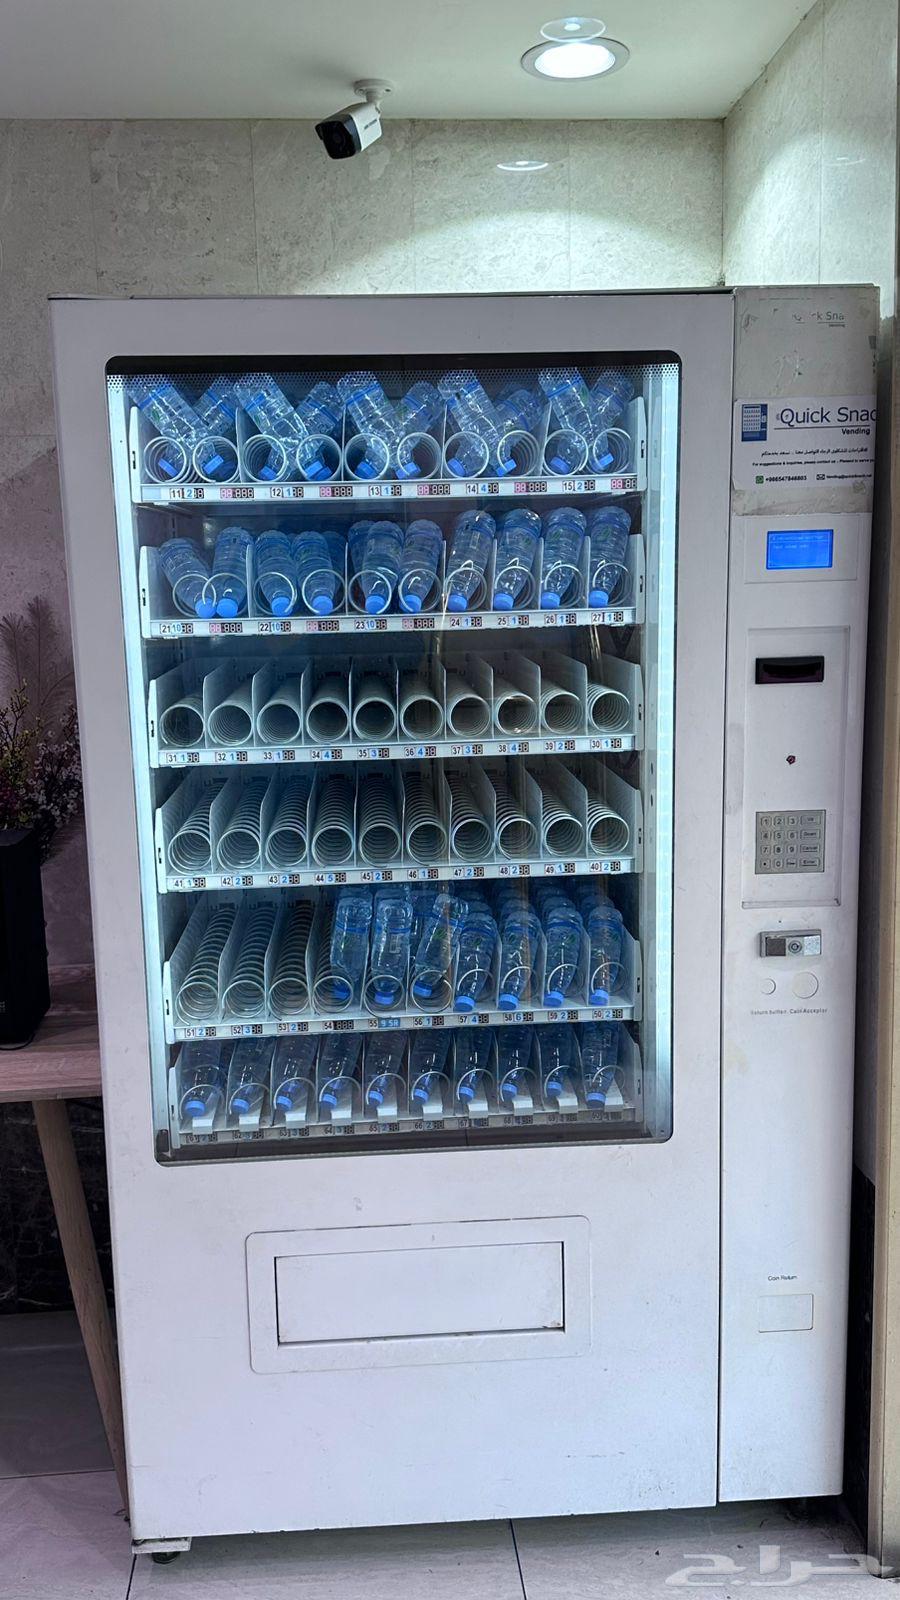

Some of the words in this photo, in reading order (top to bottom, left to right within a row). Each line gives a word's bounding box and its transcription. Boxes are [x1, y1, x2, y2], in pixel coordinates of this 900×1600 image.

[780, 407, 830, 428] Quick
[467, 486, 476, 494] 14
[564, 482, 573, 491] 15
[172, 489, 181, 498] 11
[272, 488, 281, 497] 12
[370, 487, 379, 496] 13
[498, 618, 506, 626] 25
[592, 614, 600, 622] 27
[356, 621, 364, 630] 23
[451, 618, 460, 627] 24
[162, 624, 170, 633] 21
[260, 624, 270, 632] 22
[500, 867, 508, 875] 48
[546, 866, 554, 874] 49
[590, 863, 599, 871] 40
[594, 1010, 602, 1018] 50
